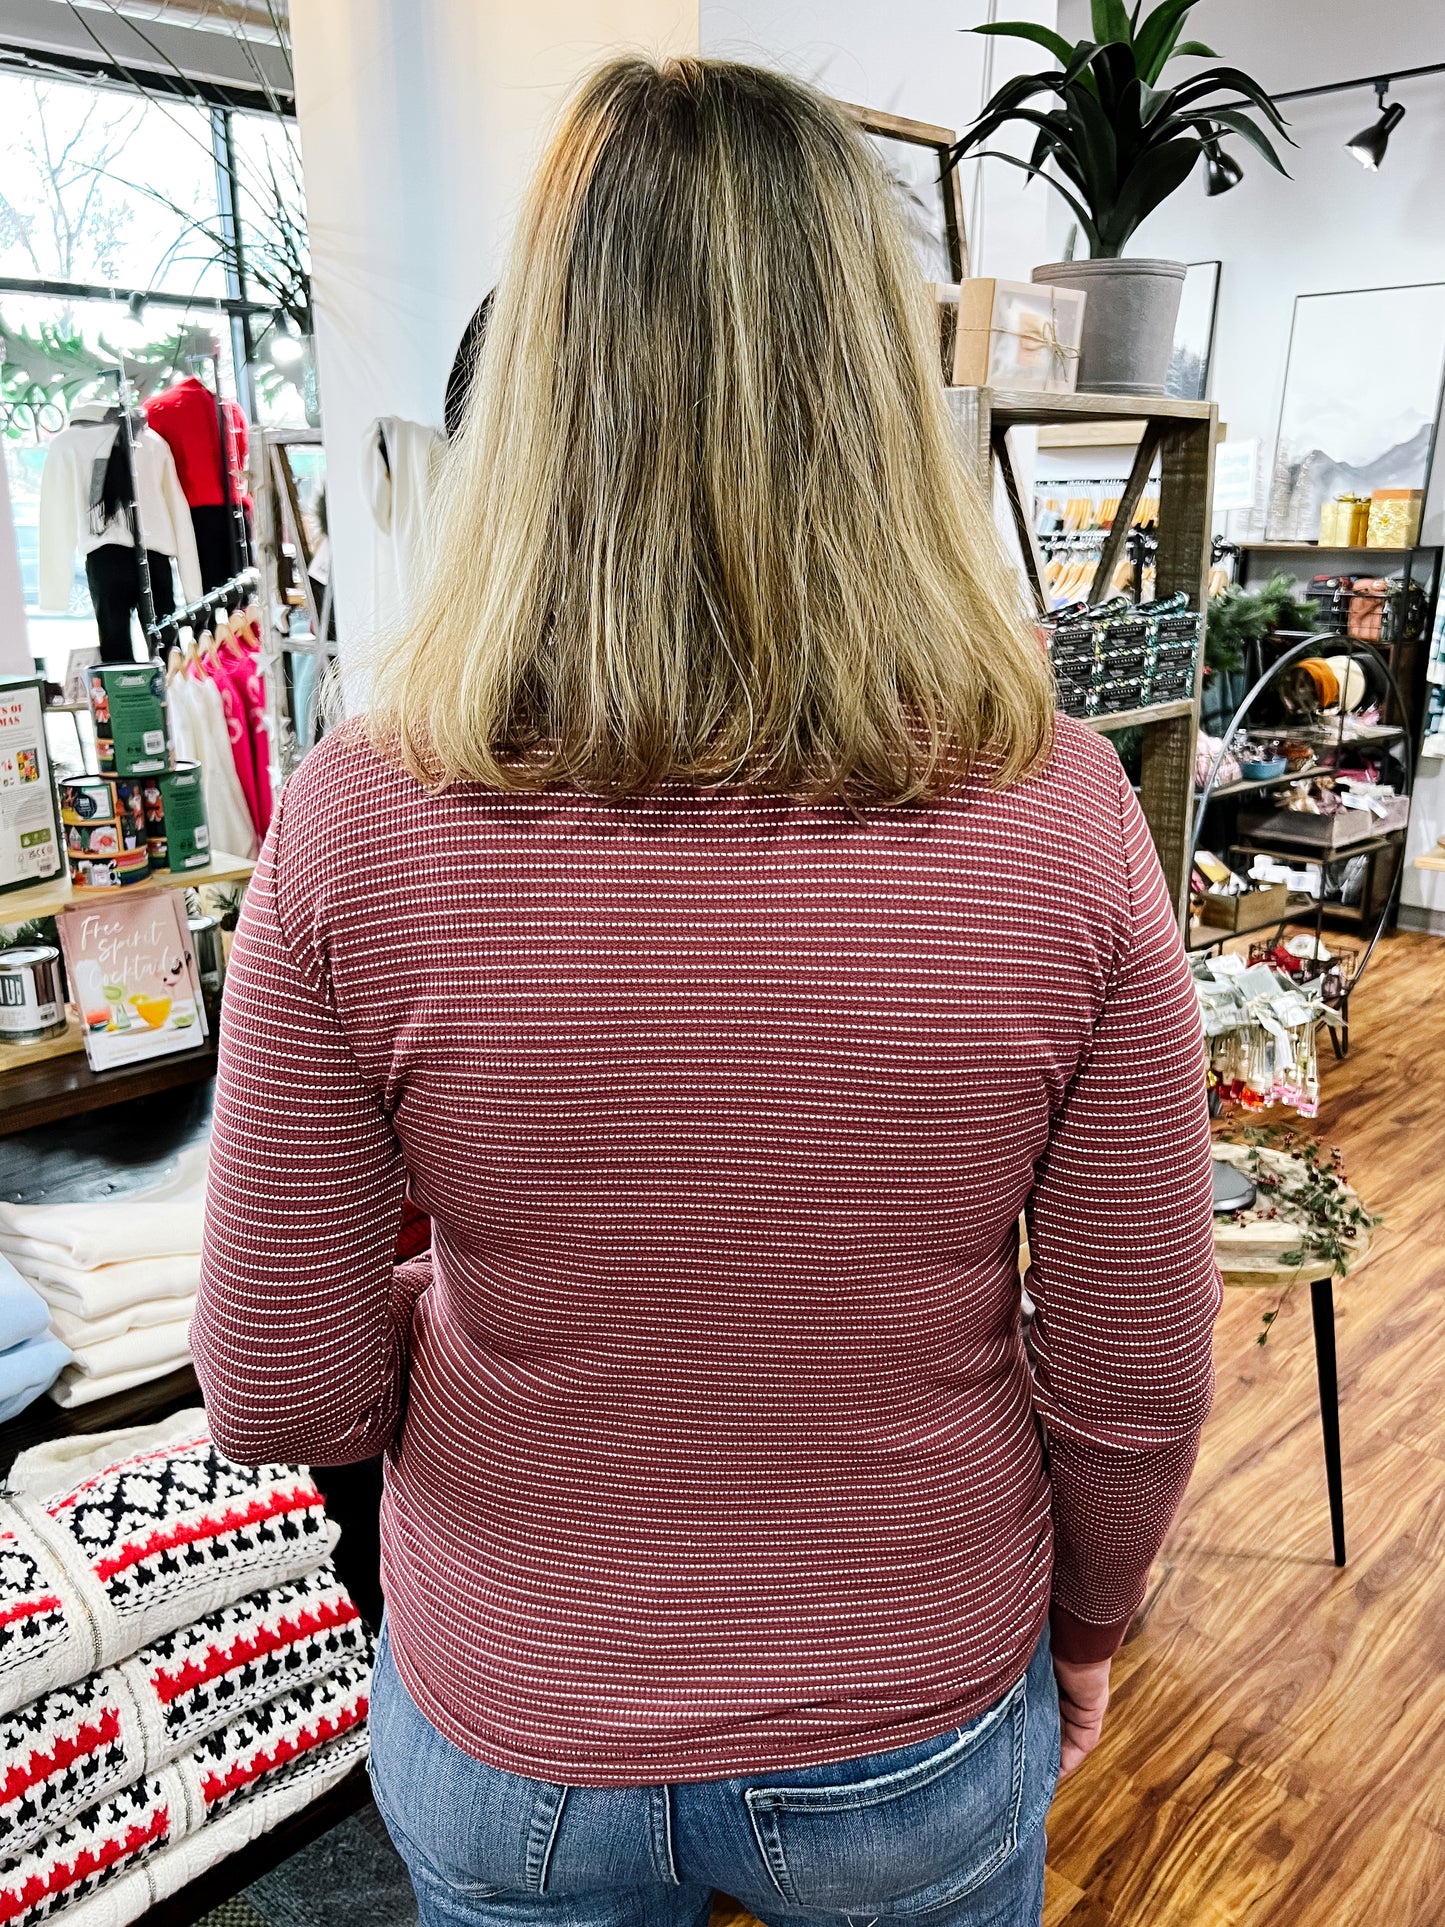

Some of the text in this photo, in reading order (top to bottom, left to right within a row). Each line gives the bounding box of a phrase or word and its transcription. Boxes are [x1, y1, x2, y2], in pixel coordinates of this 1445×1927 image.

[80, 914, 124, 950] Free
[98, 920, 167, 965] Spirit
[89, 945, 177, 991] Cocktails
